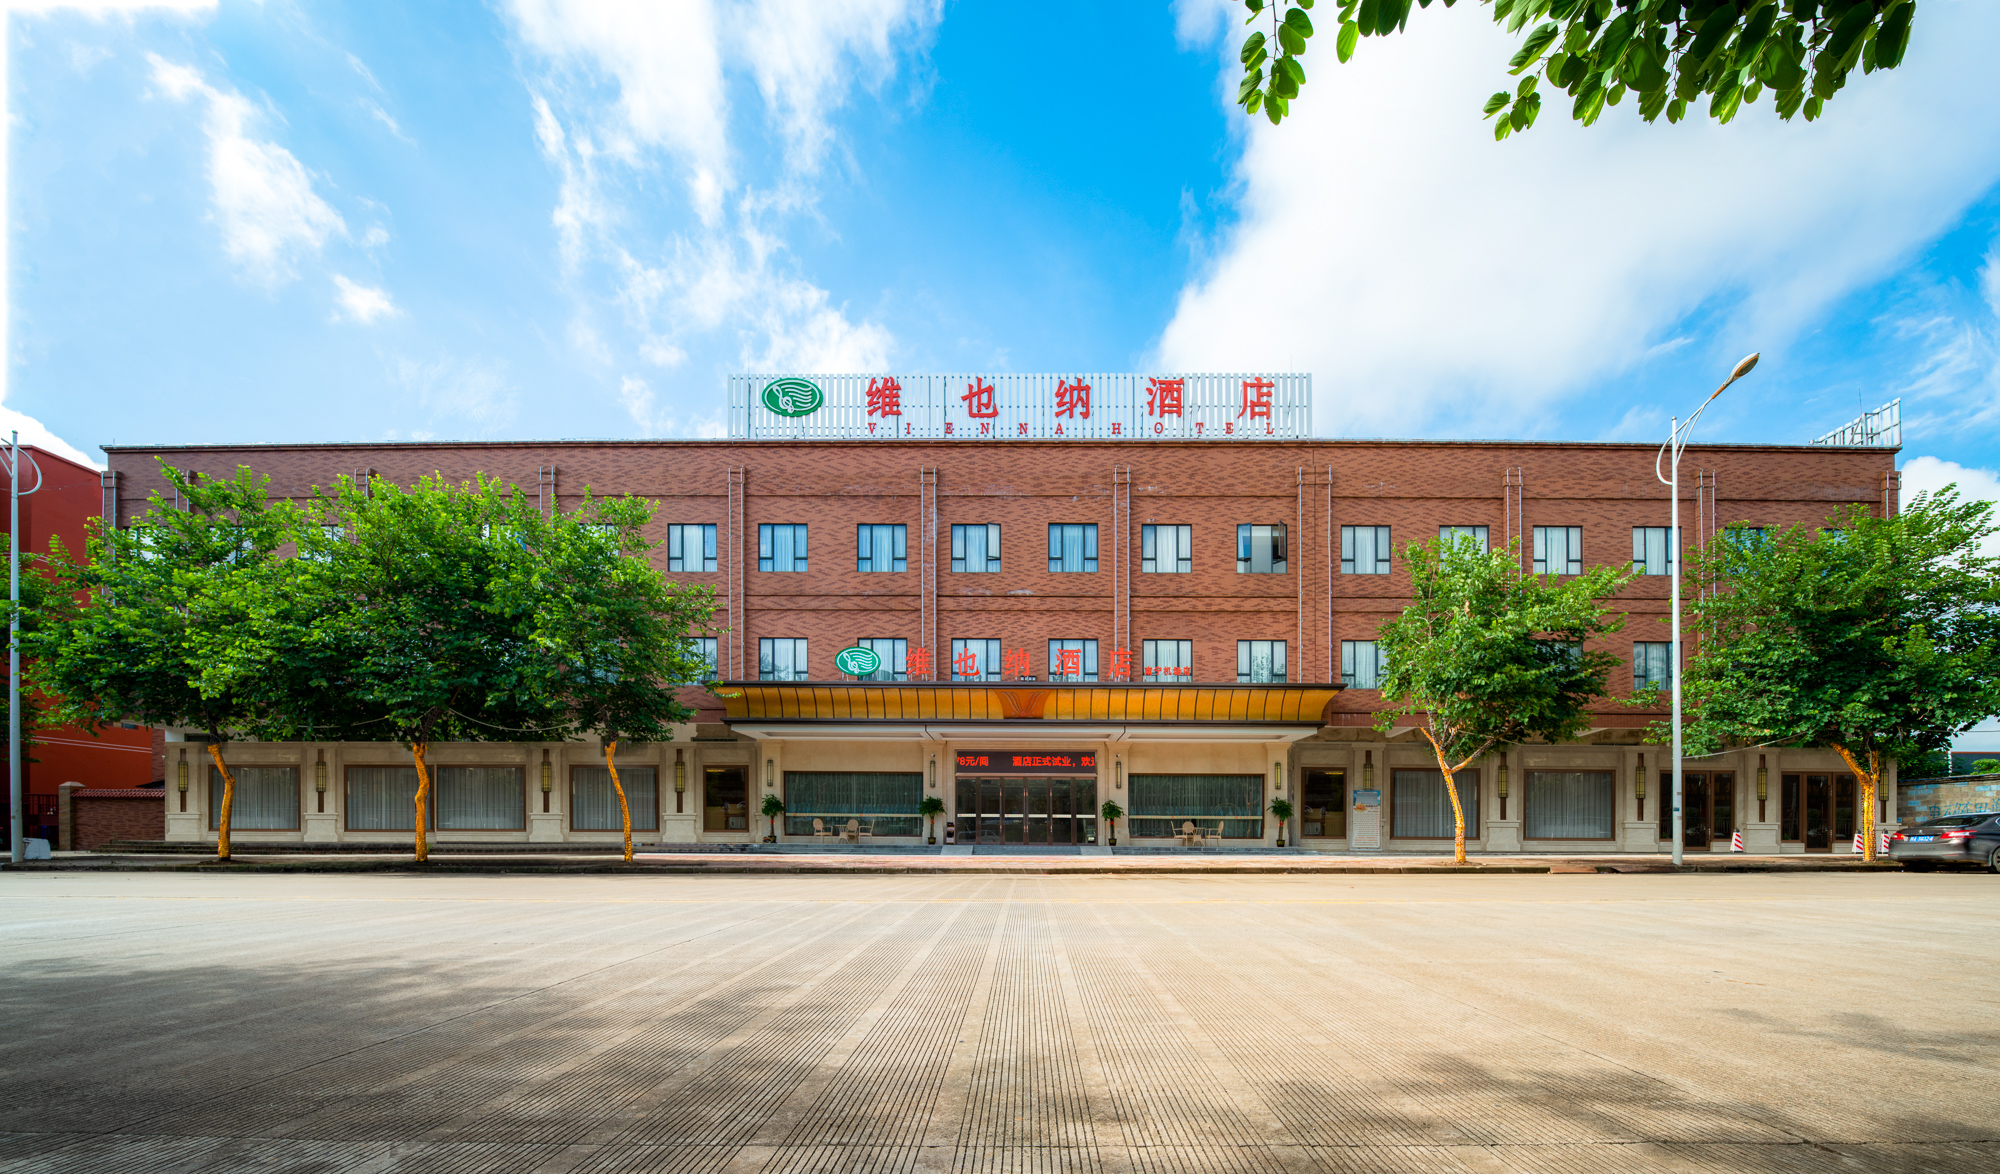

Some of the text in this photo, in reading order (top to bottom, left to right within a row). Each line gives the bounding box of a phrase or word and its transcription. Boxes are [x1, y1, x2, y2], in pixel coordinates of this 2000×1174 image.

[865, 376, 1275, 421] 维也纳酒店
[867, 421, 1274, 435] VIENNA HOTEL
[905, 647, 1133, 678] 维也纳酒店
[1144, 666, 1191, 676] 南宁机场店
